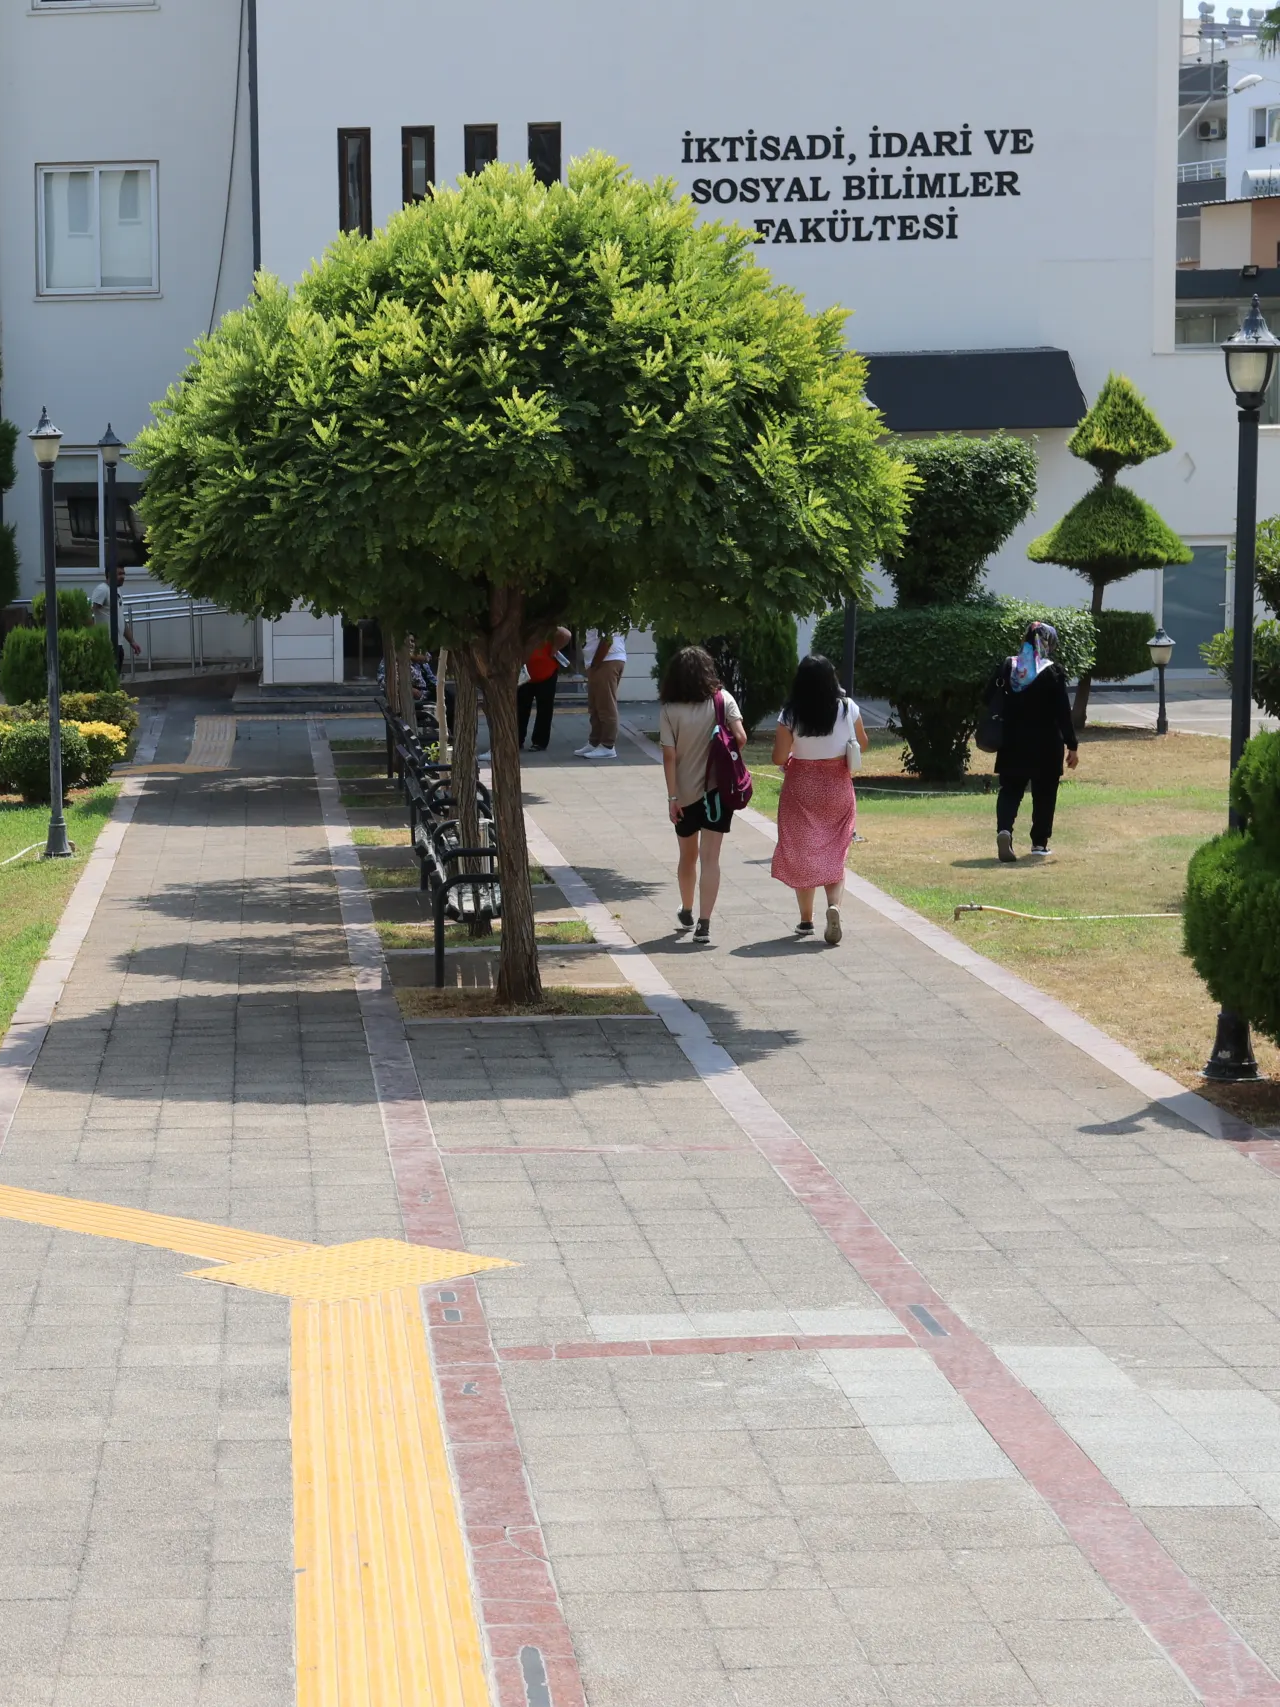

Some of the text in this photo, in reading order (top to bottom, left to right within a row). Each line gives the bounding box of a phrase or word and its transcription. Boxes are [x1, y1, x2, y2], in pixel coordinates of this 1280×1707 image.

[681, 123, 1034, 166] İKTİSADİ, İDARİ VE
[690, 166, 1021, 205] SOSYAL BİLİMLER
[753, 207, 959, 245] FAKÜLTESİ
